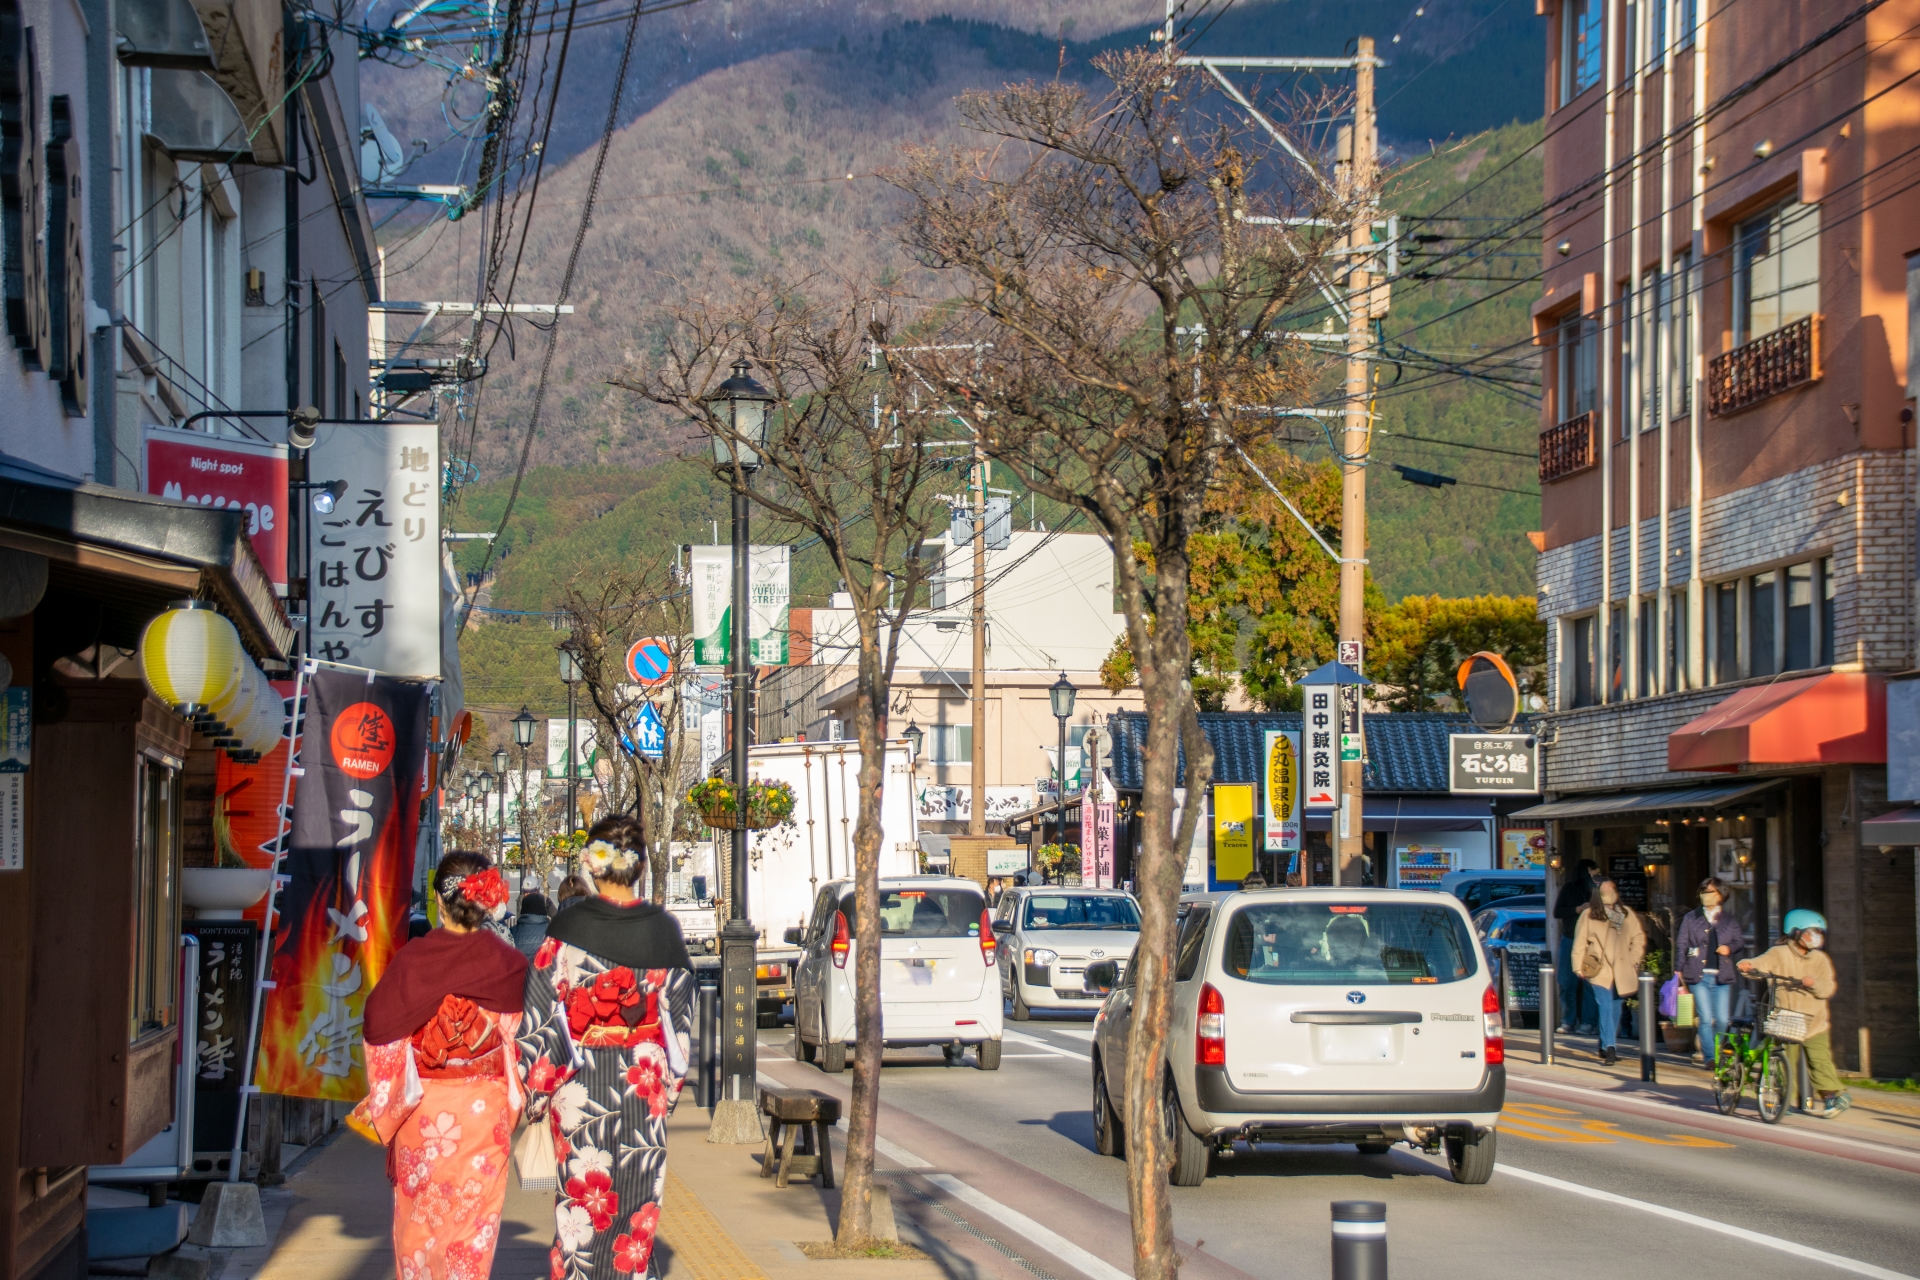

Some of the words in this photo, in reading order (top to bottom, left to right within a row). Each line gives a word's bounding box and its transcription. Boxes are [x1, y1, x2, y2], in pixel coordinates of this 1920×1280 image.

[191, 456, 218, 471] Night
[220, 463, 244, 475] spot
[400, 446, 430, 542] 地どり
[353, 488, 397, 638] えびす
[318, 518, 351, 668] ごはんや
[706, 563, 716, 629] 新町由布見通り
[751, 587, 788, 596] YUFUMI
[751, 595, 788, 604] STREET
[357, 710, 385, 742] 侍
[1312, 692, 1330, 788] 田中鍼灸院
[1473, 740, 1514, 750] 自然工房
[342, 757, 380, 773] RAMEN
[1273, 734, 1290, 819] 乙丸温泉館
[1460, 752, 1529, 773] 石ころ館
[1474, 776, 1515, 785] YUFUIN
[1084, 806, 1092, 865] 湯の花まんじゅう
[1270, 838, 1289, 847] 入口
[199, 927, 222, 935] DON'T
[223, 927, 250, 935] TOUCH
[299, 788, 375, 1077] ラーメン侍
[229, 942, 243, 980] 湯布院
[734, 984, 745, 1062] 由布見通り
[1430, 1012, 1475, 1022] ProBox
